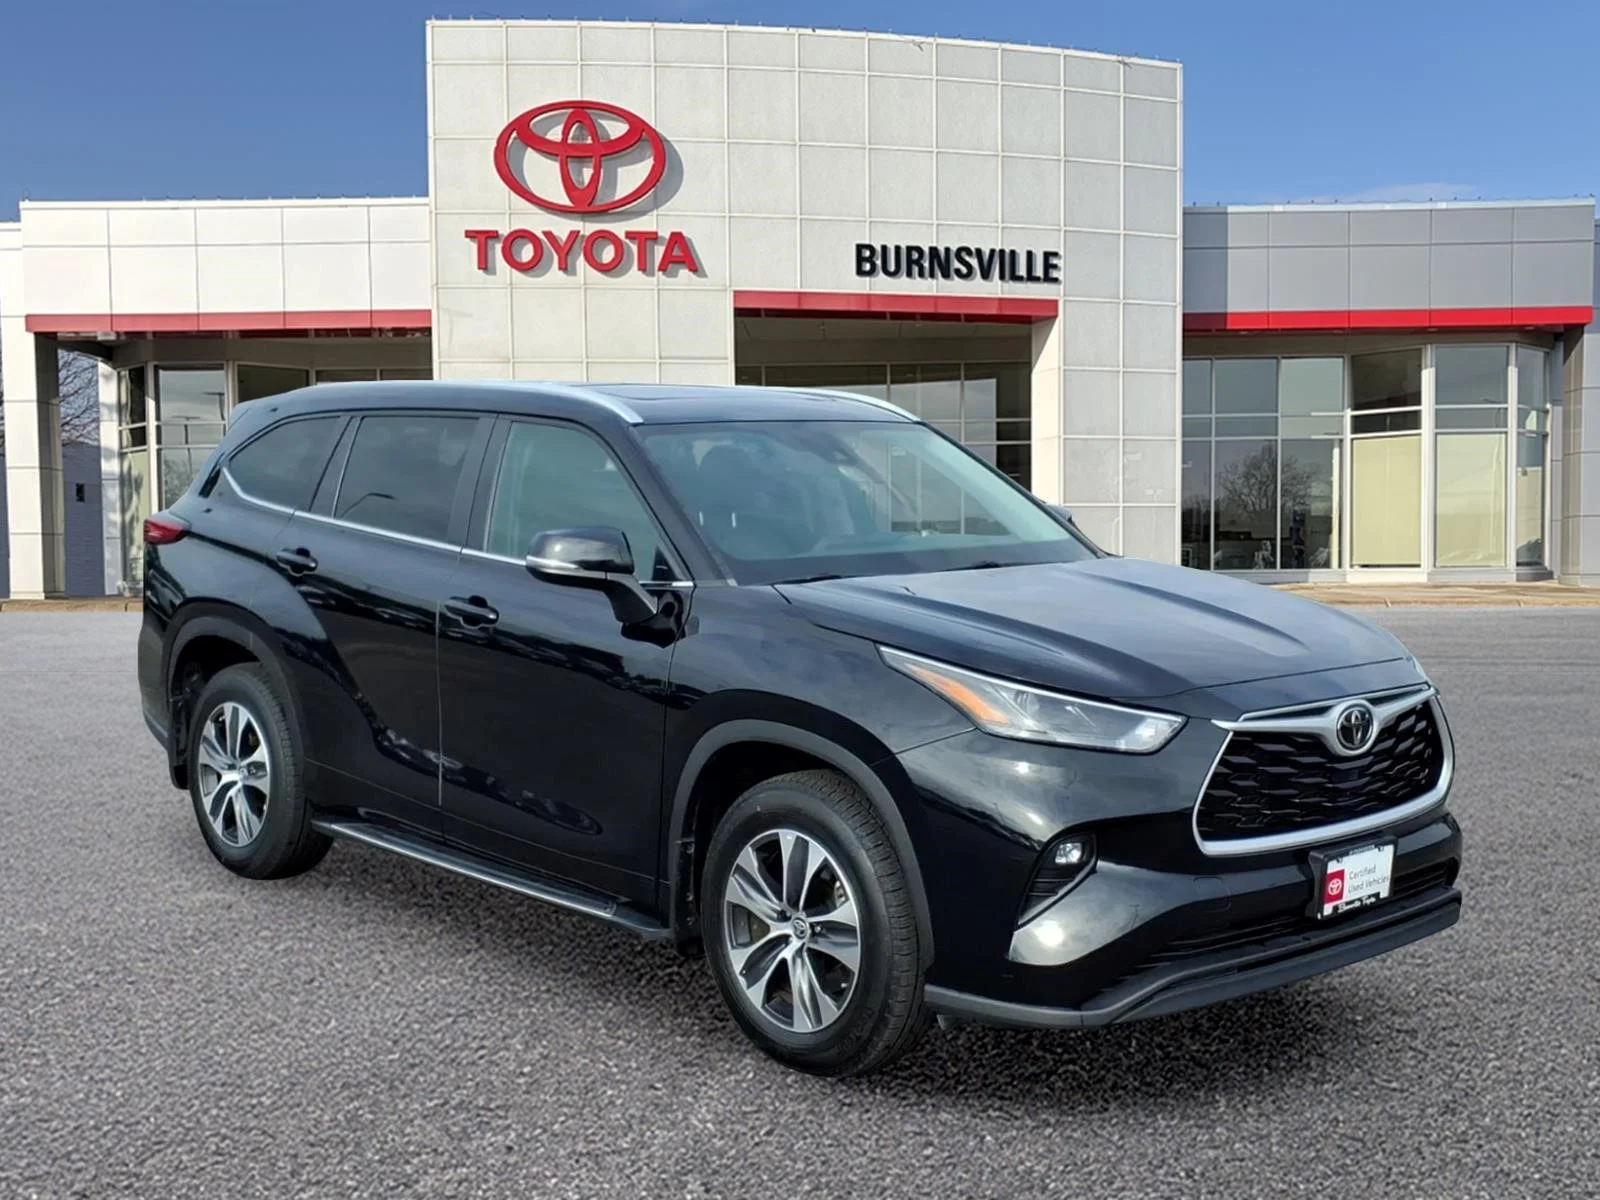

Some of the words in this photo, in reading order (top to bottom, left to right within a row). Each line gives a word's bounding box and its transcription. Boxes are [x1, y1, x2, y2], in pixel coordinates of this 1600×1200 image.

[464, 229, 699, 273] TOYOTA
[855, 243, 1061, 283] BURNSVILLE
[1348, 864, 1376, 880] Certified
[1348, 880, 1364, 893] Used
